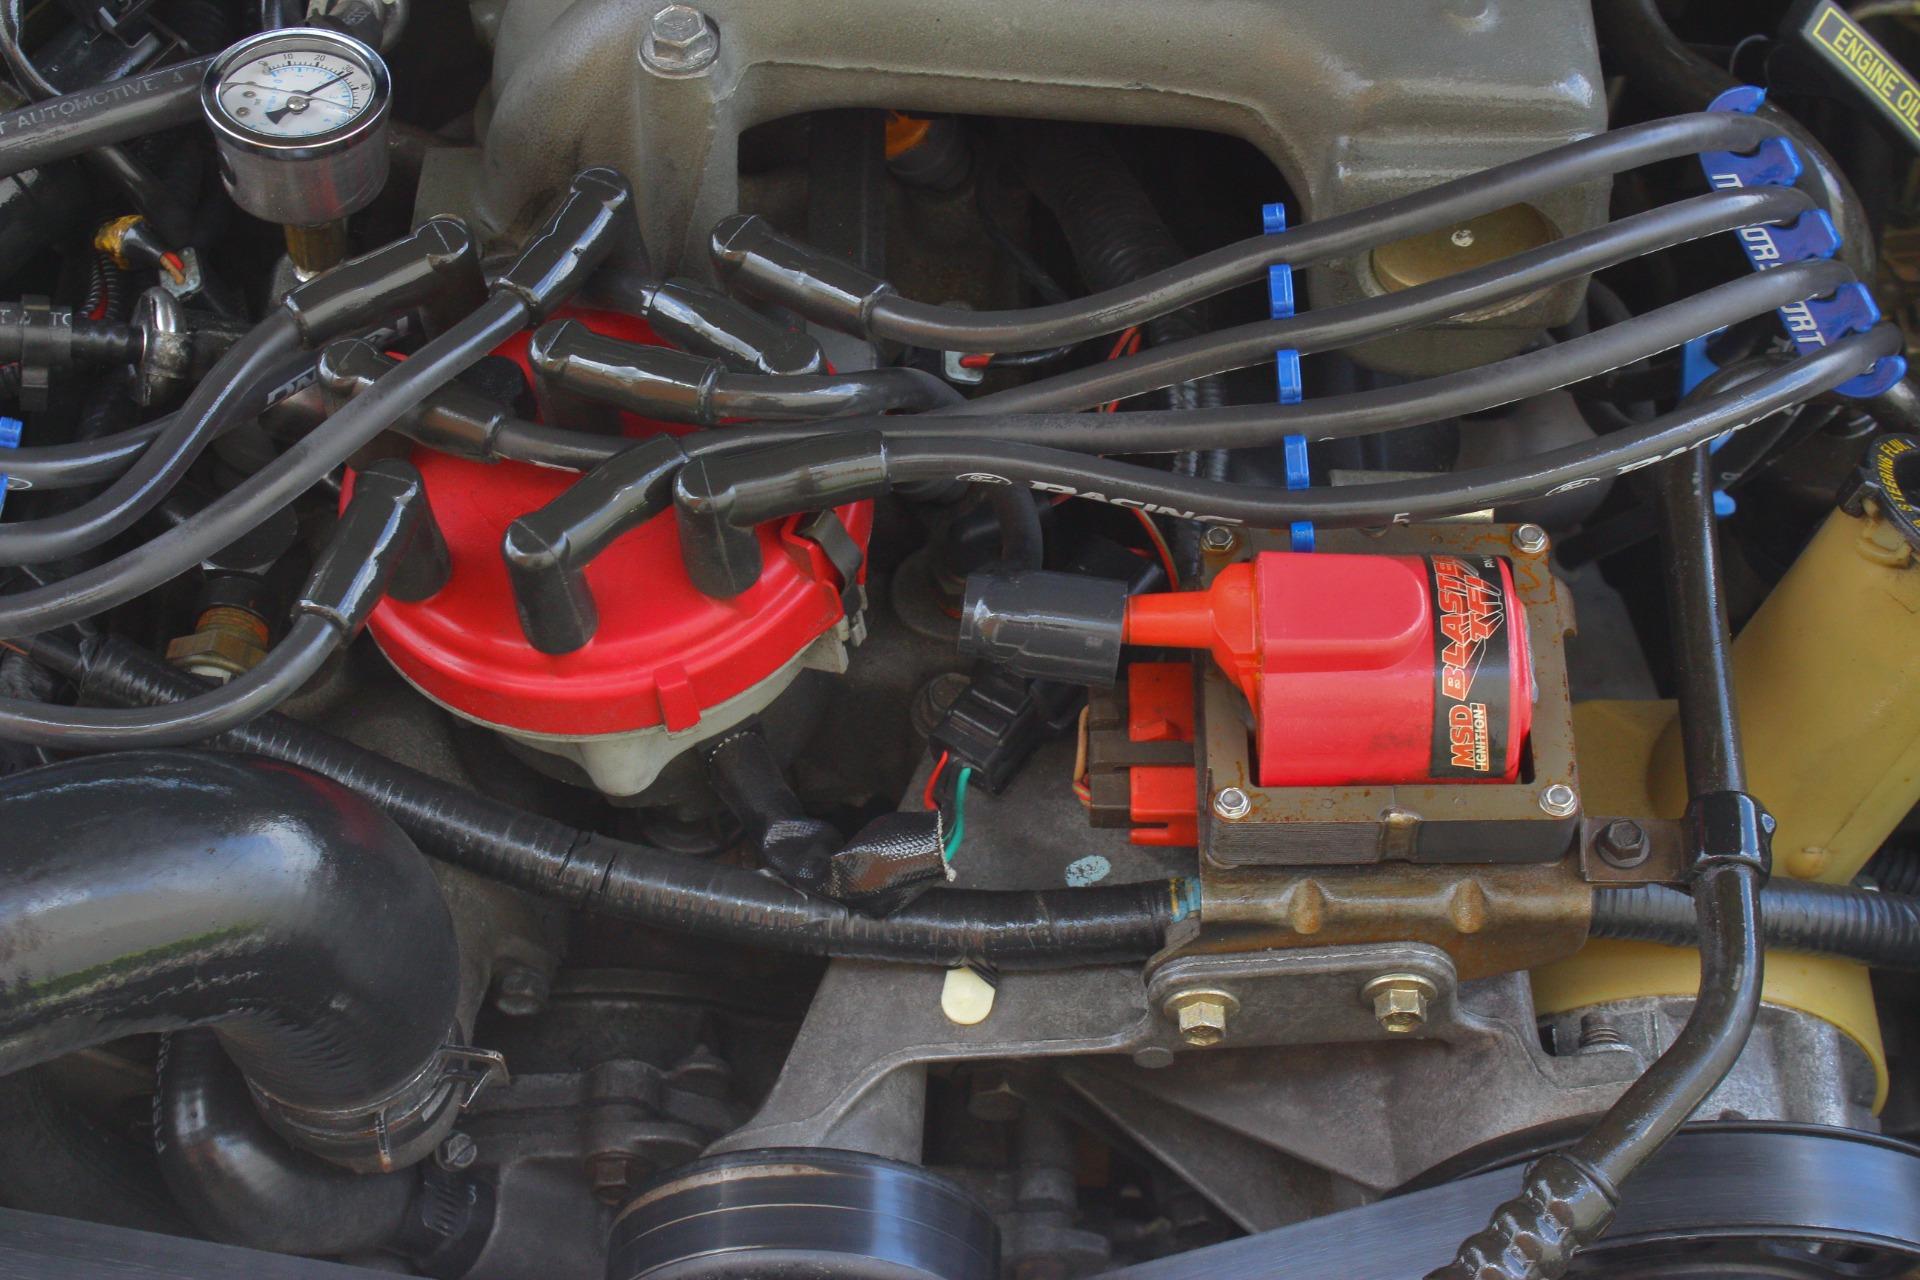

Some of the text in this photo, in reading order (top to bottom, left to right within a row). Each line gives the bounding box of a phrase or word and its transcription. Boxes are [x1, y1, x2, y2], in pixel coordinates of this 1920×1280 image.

[1832, 27, 1899, 98] ENGINE
[17, 78, 159, 129] AUTOMOTIVE
[1876, 453, 1913, 512] STEERING
[1449, 704, 1475, 768] MSD
[1472, 707, 1487, 767] IGNITION
